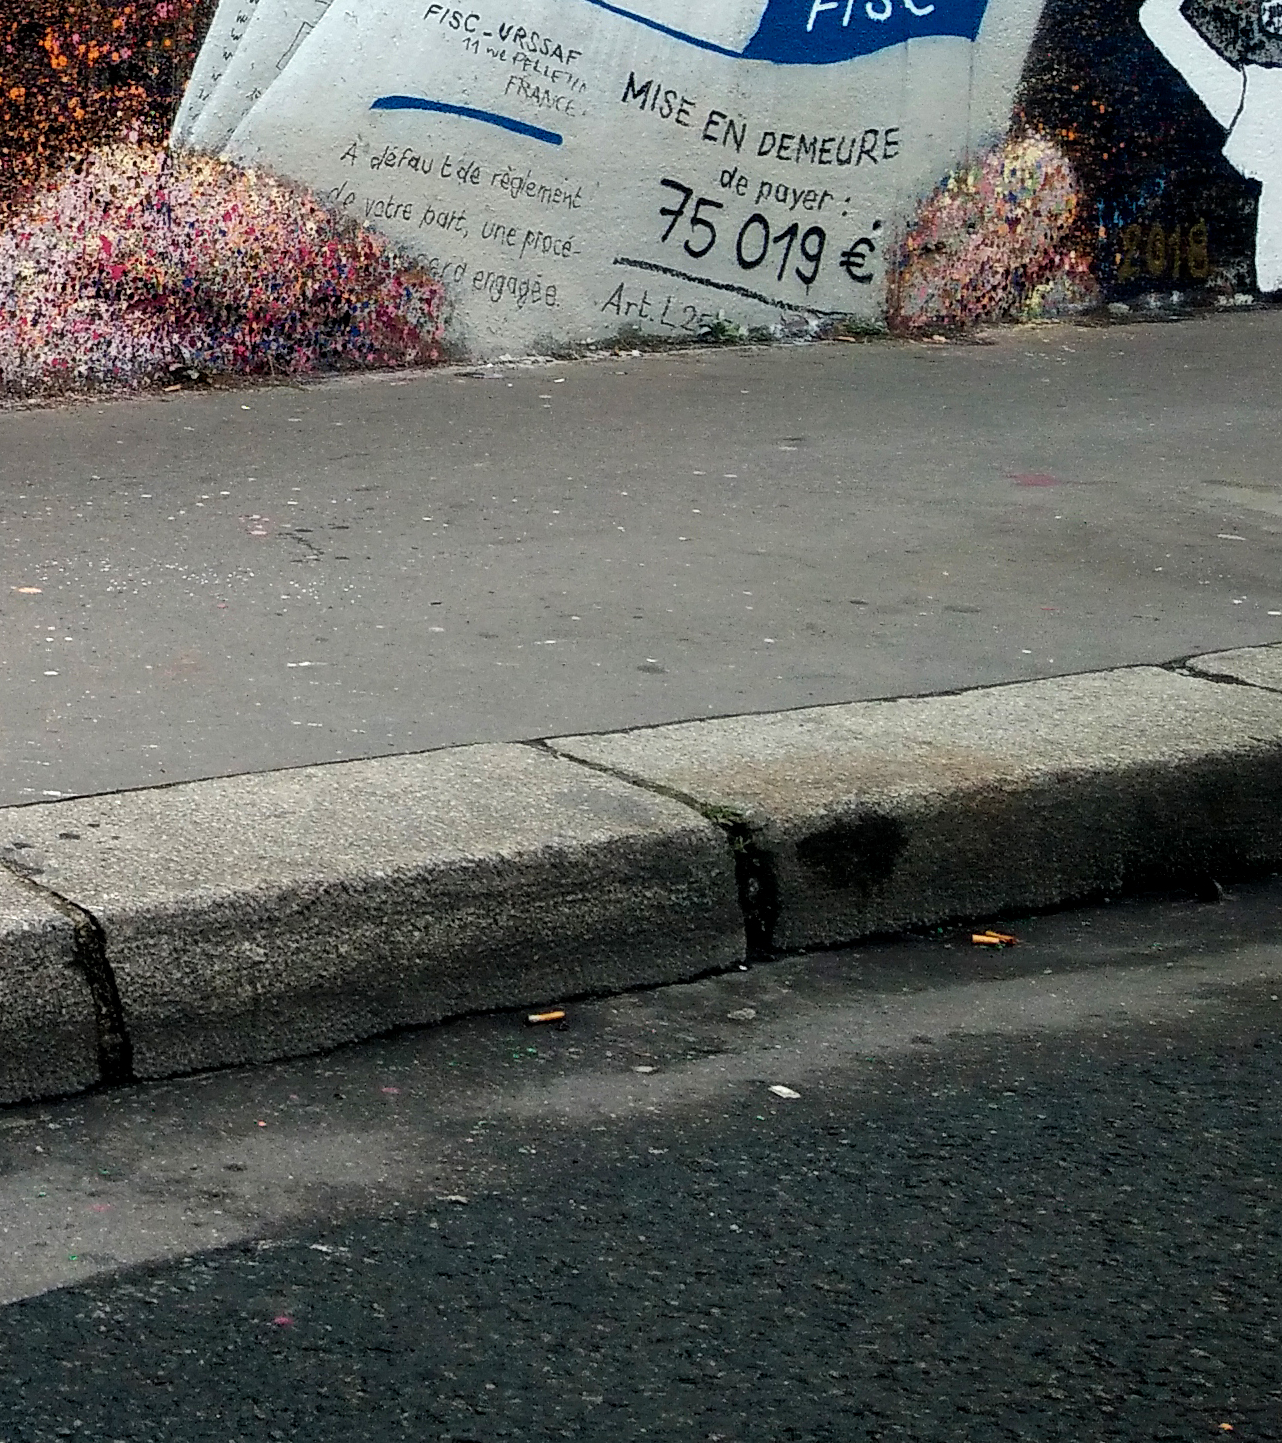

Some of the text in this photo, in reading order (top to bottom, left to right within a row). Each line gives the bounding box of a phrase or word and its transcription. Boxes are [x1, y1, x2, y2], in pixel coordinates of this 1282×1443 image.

[621, 71, 901, 166] MISE EN DEMEURE
[456, 160, 481, 186] de
[720, 165, 749, 197] de
[659, 177, 877, 288] 75 019 €
